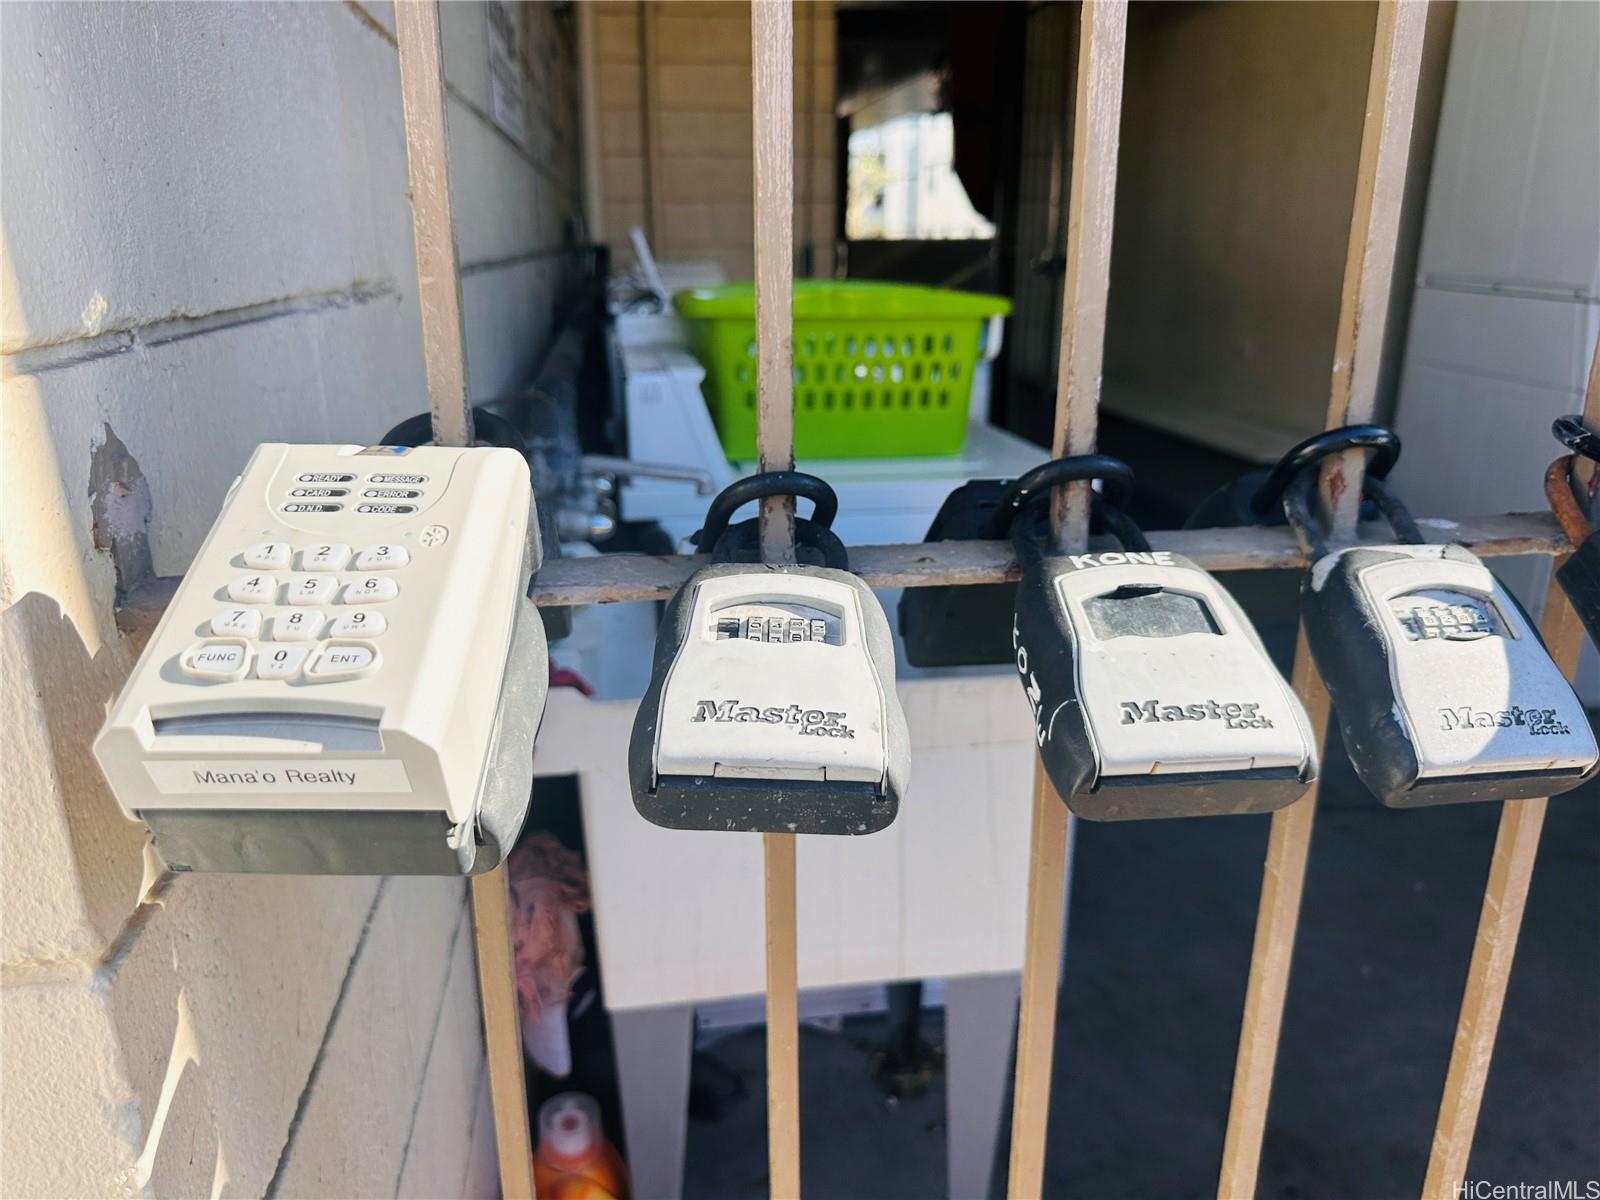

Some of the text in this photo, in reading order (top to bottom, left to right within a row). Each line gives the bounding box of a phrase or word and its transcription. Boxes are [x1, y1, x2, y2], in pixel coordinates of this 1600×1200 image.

[383, 475, 421, 483] MESSAGE
[265, 545, 274, 554] 1
[317, 546, 331, 556] 2
[376, 546, 389, 556] 3
[1068, 551, 1176, 569] KONE
[247, 577, 260, 587] 4
[304, 578, 319, 589] 5
[365, 578, 378, 589] 6
[232, 611, 246, 622] 7
[289, 613, 303, 624] 8
[352, 612, 366, 623] 9
[197, 652, 238, 662] FUNC
[274, 650, 288, 662] 0
[330, 654, 361, 663] ENT
[690, 700, 855, 739] Master Lock
[1120, 699, 1274, 730] Master Lock
[1439, 706, 1571, 736] Master Lock
[192, 769, 357, 785] Mana'o Realty
